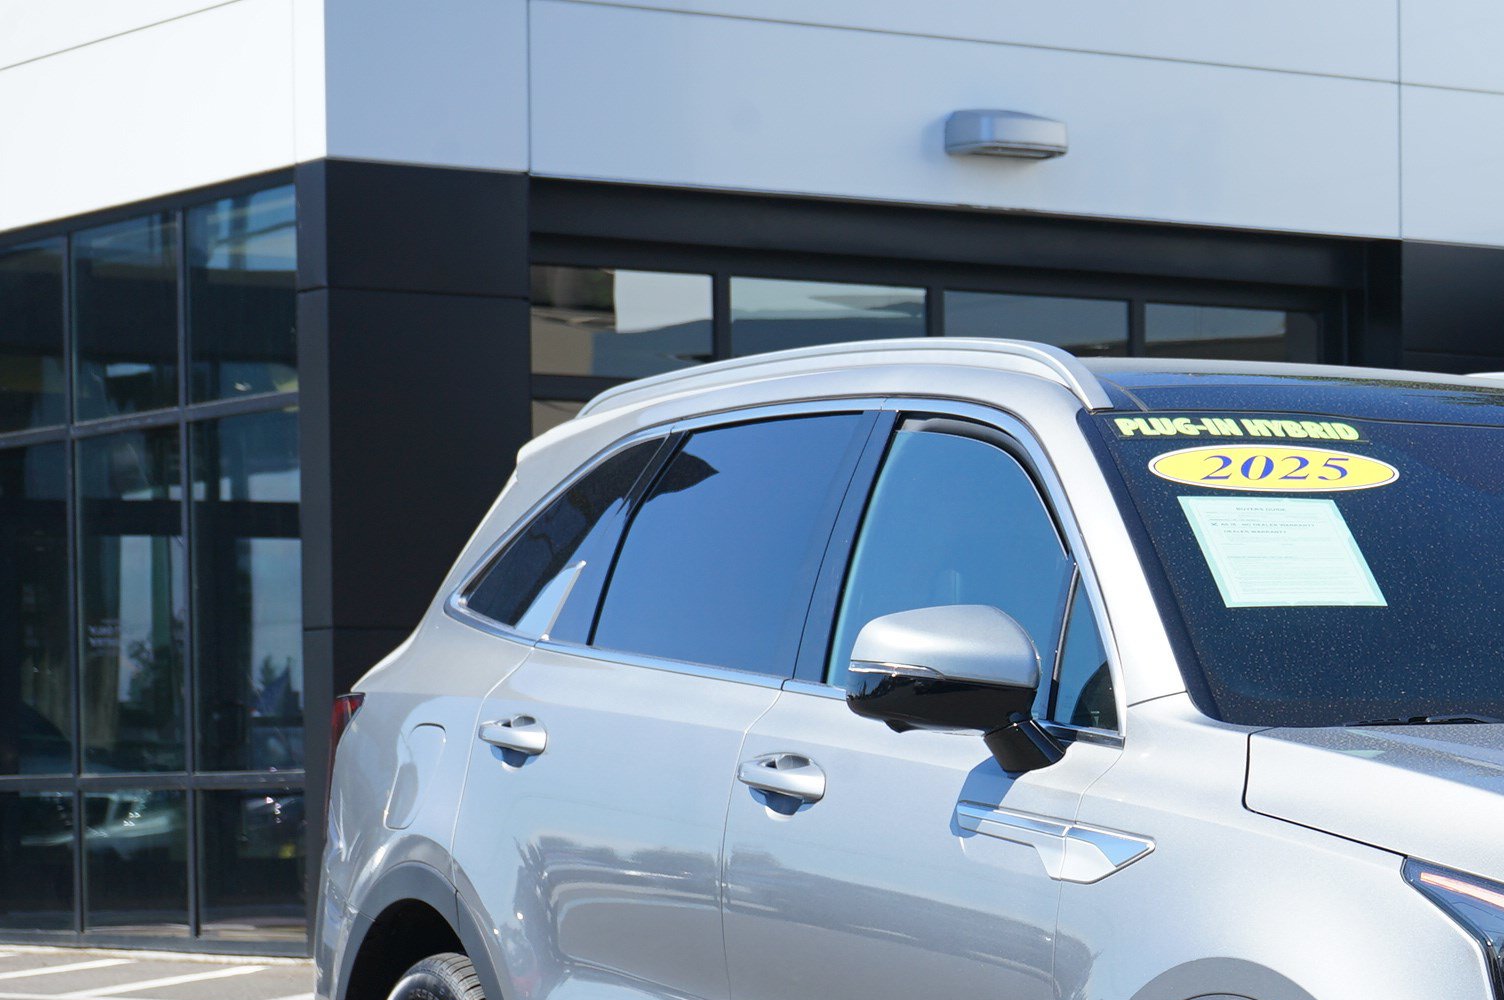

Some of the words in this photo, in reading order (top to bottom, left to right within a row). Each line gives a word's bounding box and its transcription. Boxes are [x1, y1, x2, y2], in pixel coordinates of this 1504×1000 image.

[1113, 417, 1243, 437] PLUG-IN
[1241, 418, 1360, 441] HYBRID
[1201, 455, 1349, 481] 2025
